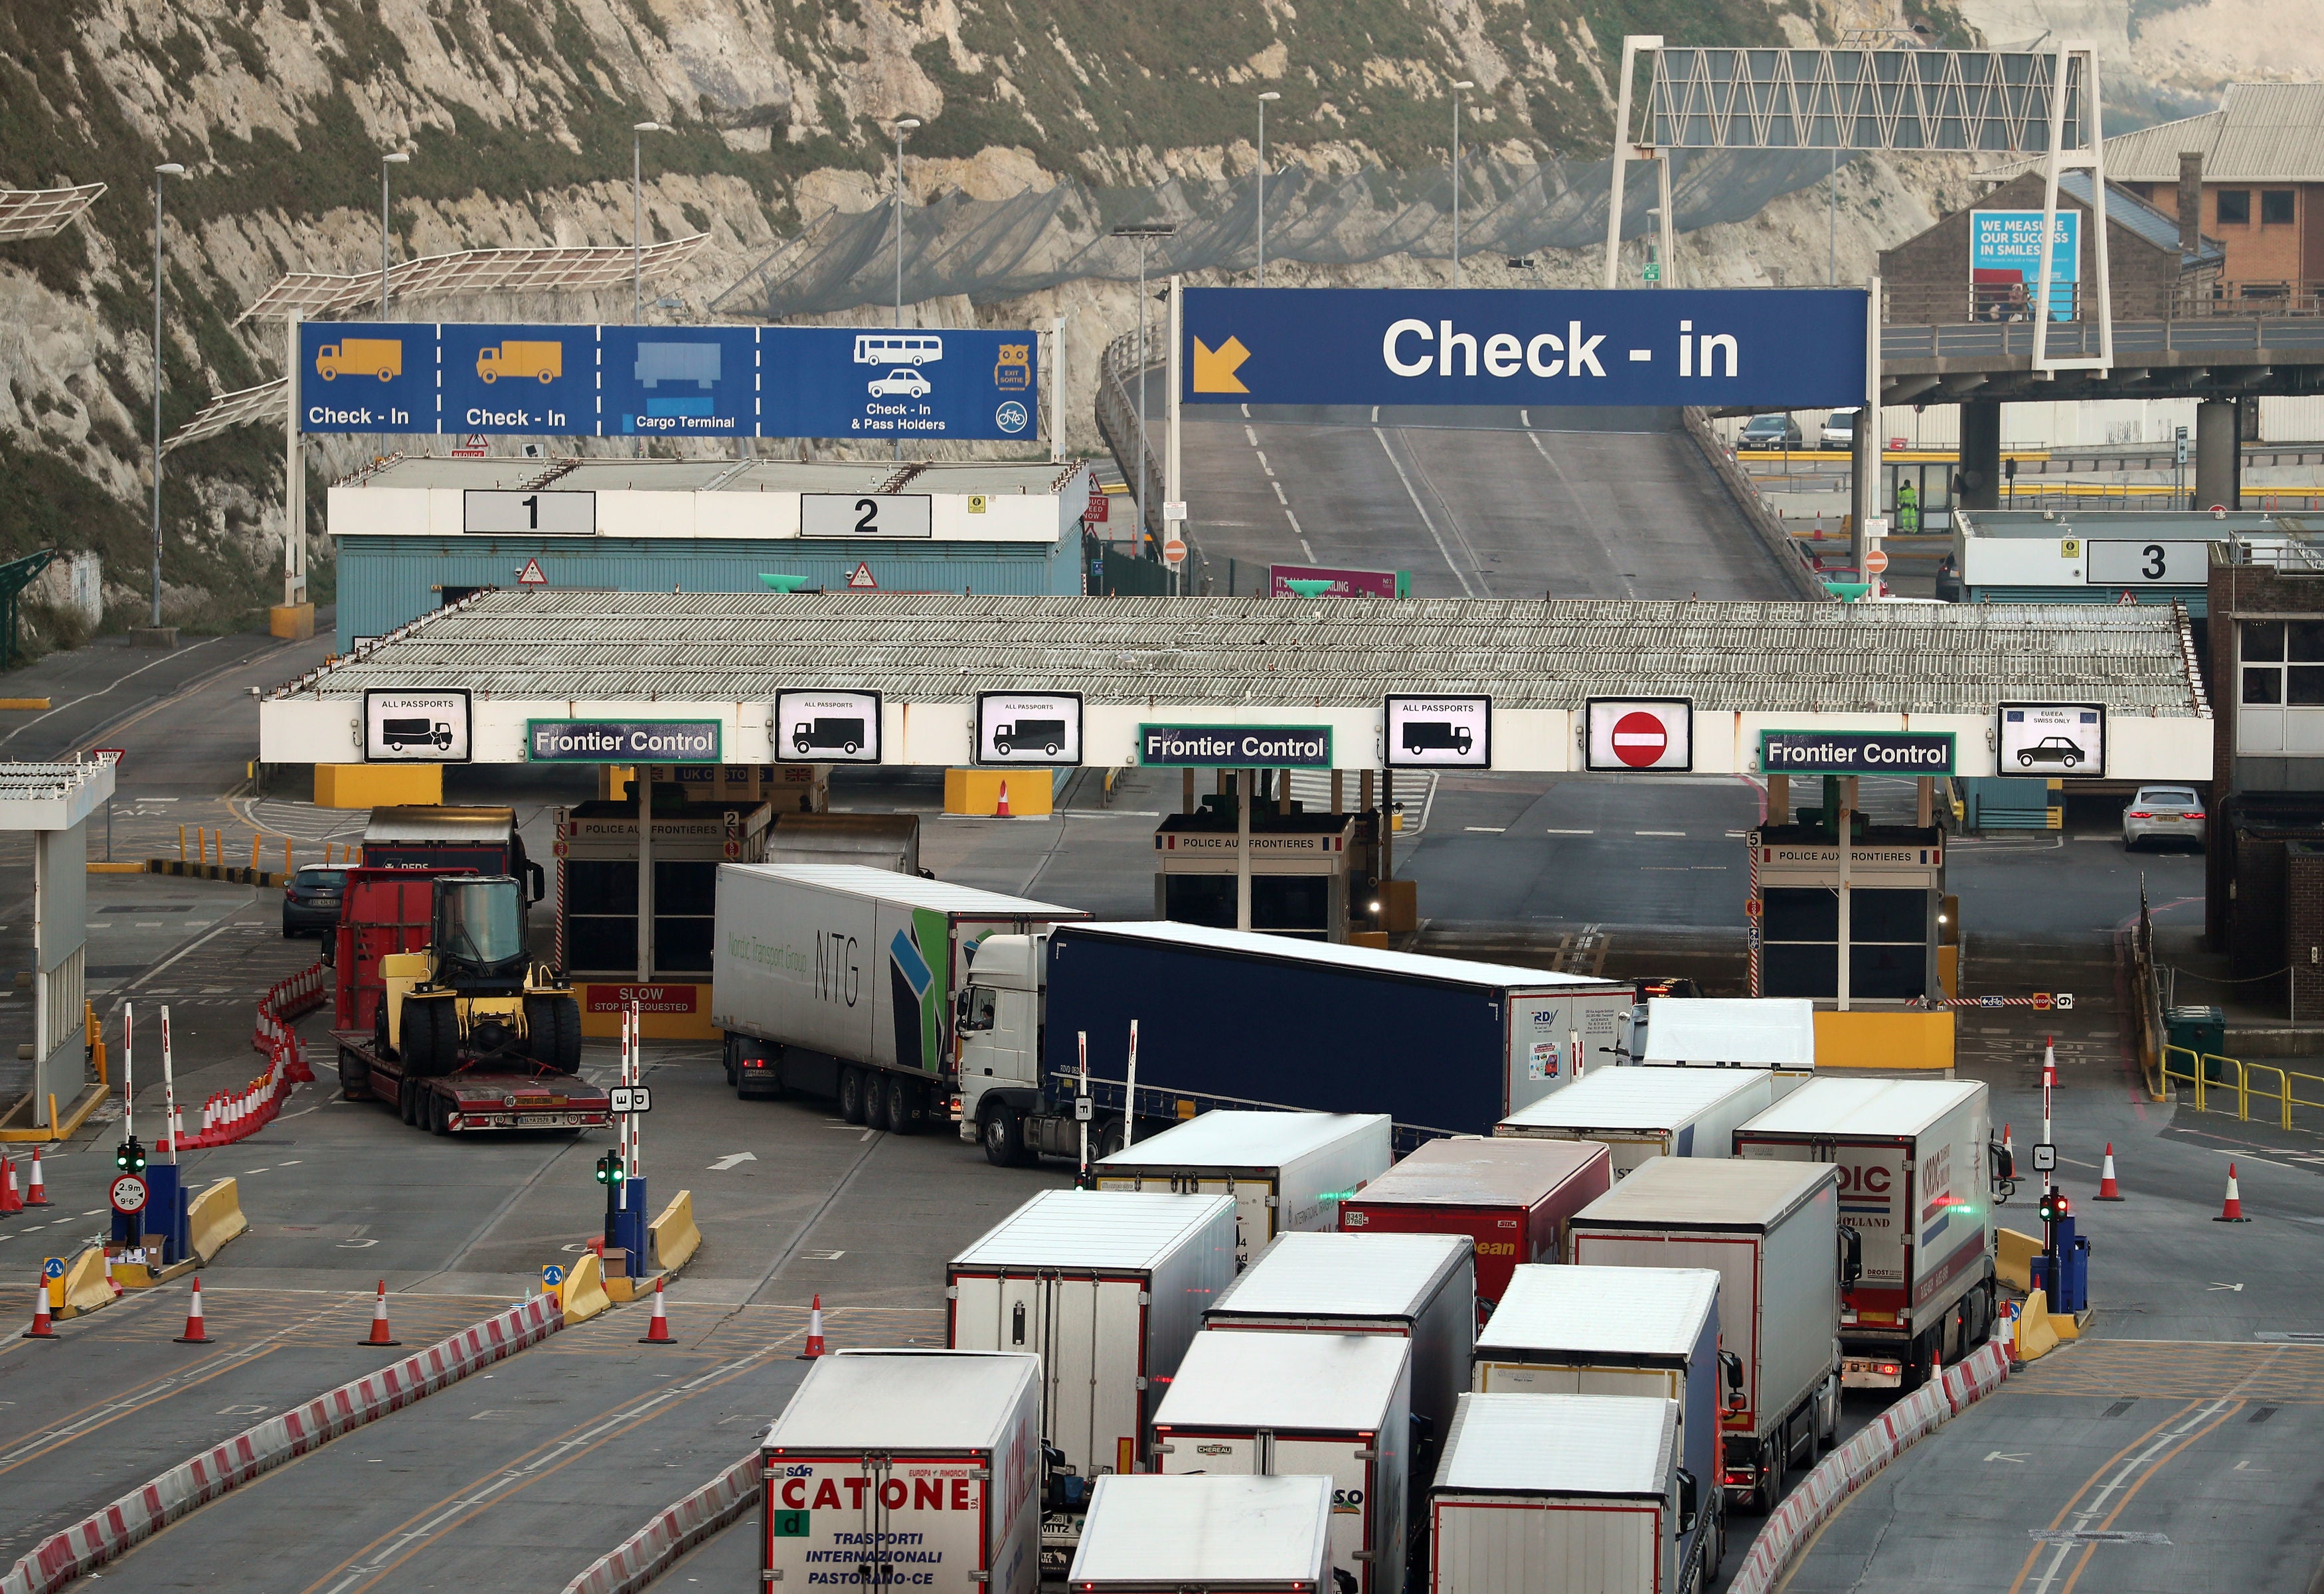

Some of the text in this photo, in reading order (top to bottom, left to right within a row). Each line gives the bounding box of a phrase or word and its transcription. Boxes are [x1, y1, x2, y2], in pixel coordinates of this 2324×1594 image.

[1981, 220, 2064, 232] WE MEASE
[1981, 233, 2068, 243] OUR SUCCSS
[1981, 246, 1993, 255] IN
[1382, 319, 1606, 378] Check
[1679, 320, 1738, 378] in
[866, 403, 905, 415] Check
[919, 404, 930, 415] In
[308, 407, 371, 424] Check
[390, 408, 409, 424] In
[466, 409, 527, 426] Check
[548, 410, 566, 426] In
[635, 416, 735, 431] Cargo Terminal
[851, 418, 946, 430] & Pass Holders
[522, 495, 537, 528] 1
[855, 499, 878, 532] 2
[2141, 544, 2166, 580] 3
[1327, 580, 1349, 593] AILING
[536, 730, 713, 751] Frontier Control
[1148, 736, 1323, 757] Frontier Control
[1769, 743, 1947, 764] Frontier Control
[683, 769, 765, 779] UK CSTOS
[558, 811, 564, 823] 1
[727, 813, 736, 825] 2
[627, 825, 639, 834] AU
[651, 825, 717, 834] FRONTIERES
[1183, 838, 1313, 848] POLICE AU FRONTIERES
[1750, 833, 1758, 845] 5
[1780, 852, 1817, 860] POLICE
[1851, 852, 1911, 861] RONTIERES
[728, 931, 807, 982] Nordic Transport Group
[815, 929, 859, 1008] NTG
[620, 988, 664, 1000] SLOW
[617, 1095, 626, 1104] E
[635, 1095, 644, 1104] D
[1838, 1165, 1891, 1192] DIC
[1923, 1151, 1940, 1202] NORDIC
[1839, 1217, 1890, 1227] OLLAND
[782, 1477, 969, 1510] CATONE
[1333, 1489, 1363, 1504] SO
[784, 1513, 799, 1534] d
[833, 1533, 923, 1545] TRASPORTI
[805, 1551, 942, 1563] INTERNAZIONALI
[808, 1573, 934, 1584] PASTORANO-CE
